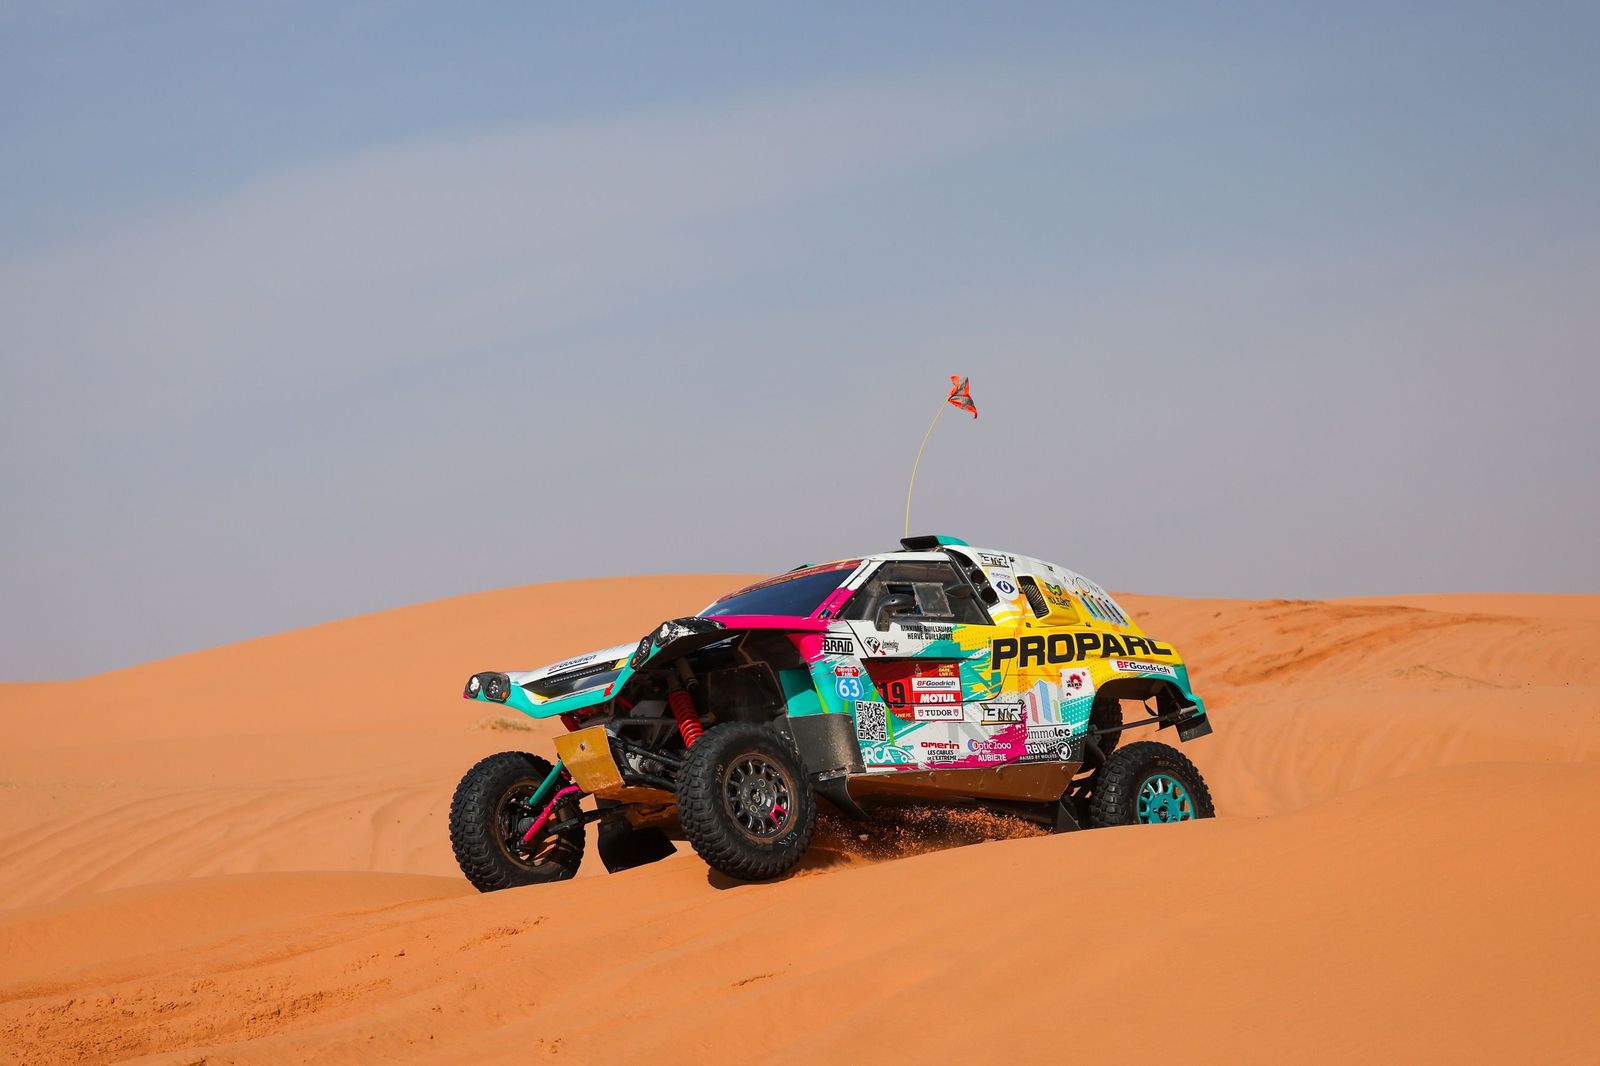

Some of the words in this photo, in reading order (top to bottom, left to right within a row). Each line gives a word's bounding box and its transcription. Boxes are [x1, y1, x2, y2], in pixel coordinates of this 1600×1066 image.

[824, 640, 854, 652] BRAID
[1116, 661, 1170, 673] BFGoodrich
[839, 679, 860, 697] 63
[920, 693, 956, 703] MOTUL
[1027, 727, 1071, 739] immolec
[921, 741, 960, 749] omerin
[1025, 743, 1048, 754] RBW
[865, 746, 896, 763] RCA
